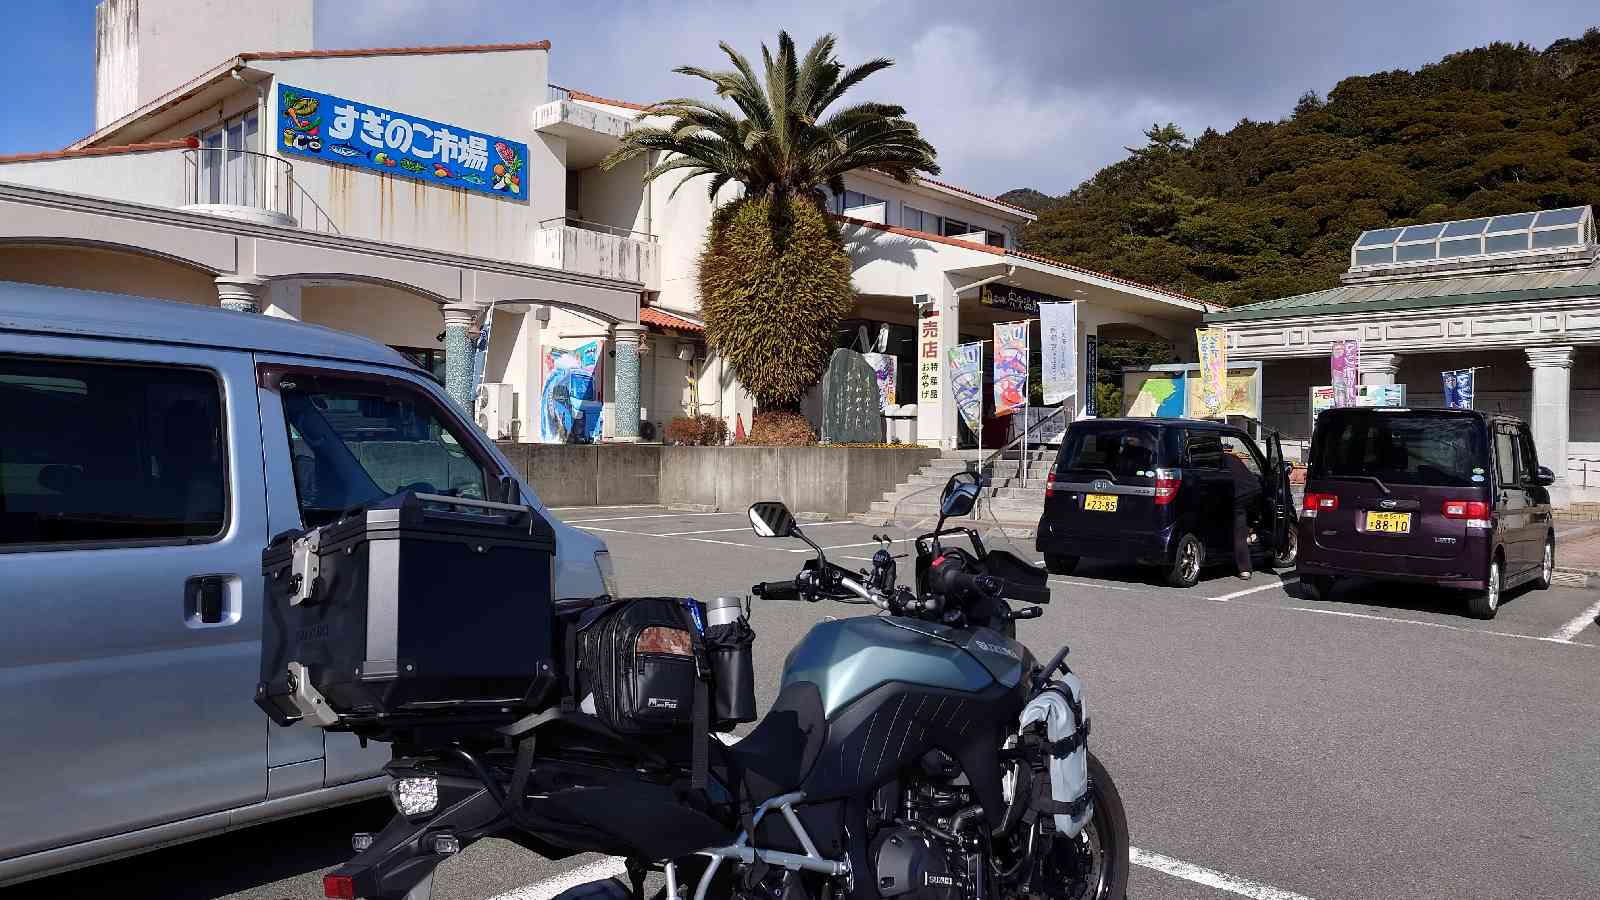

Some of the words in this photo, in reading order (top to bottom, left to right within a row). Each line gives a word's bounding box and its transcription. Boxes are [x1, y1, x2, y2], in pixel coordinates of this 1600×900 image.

[328, 104, 489, 171] すぎのこ市場
[922, 320, 939, 359] 売店
[921, 362, 930, 399] おみやげ
[930, 362, 939, 399] 特産品
[1375, 519, 1408, 532] 88-10
